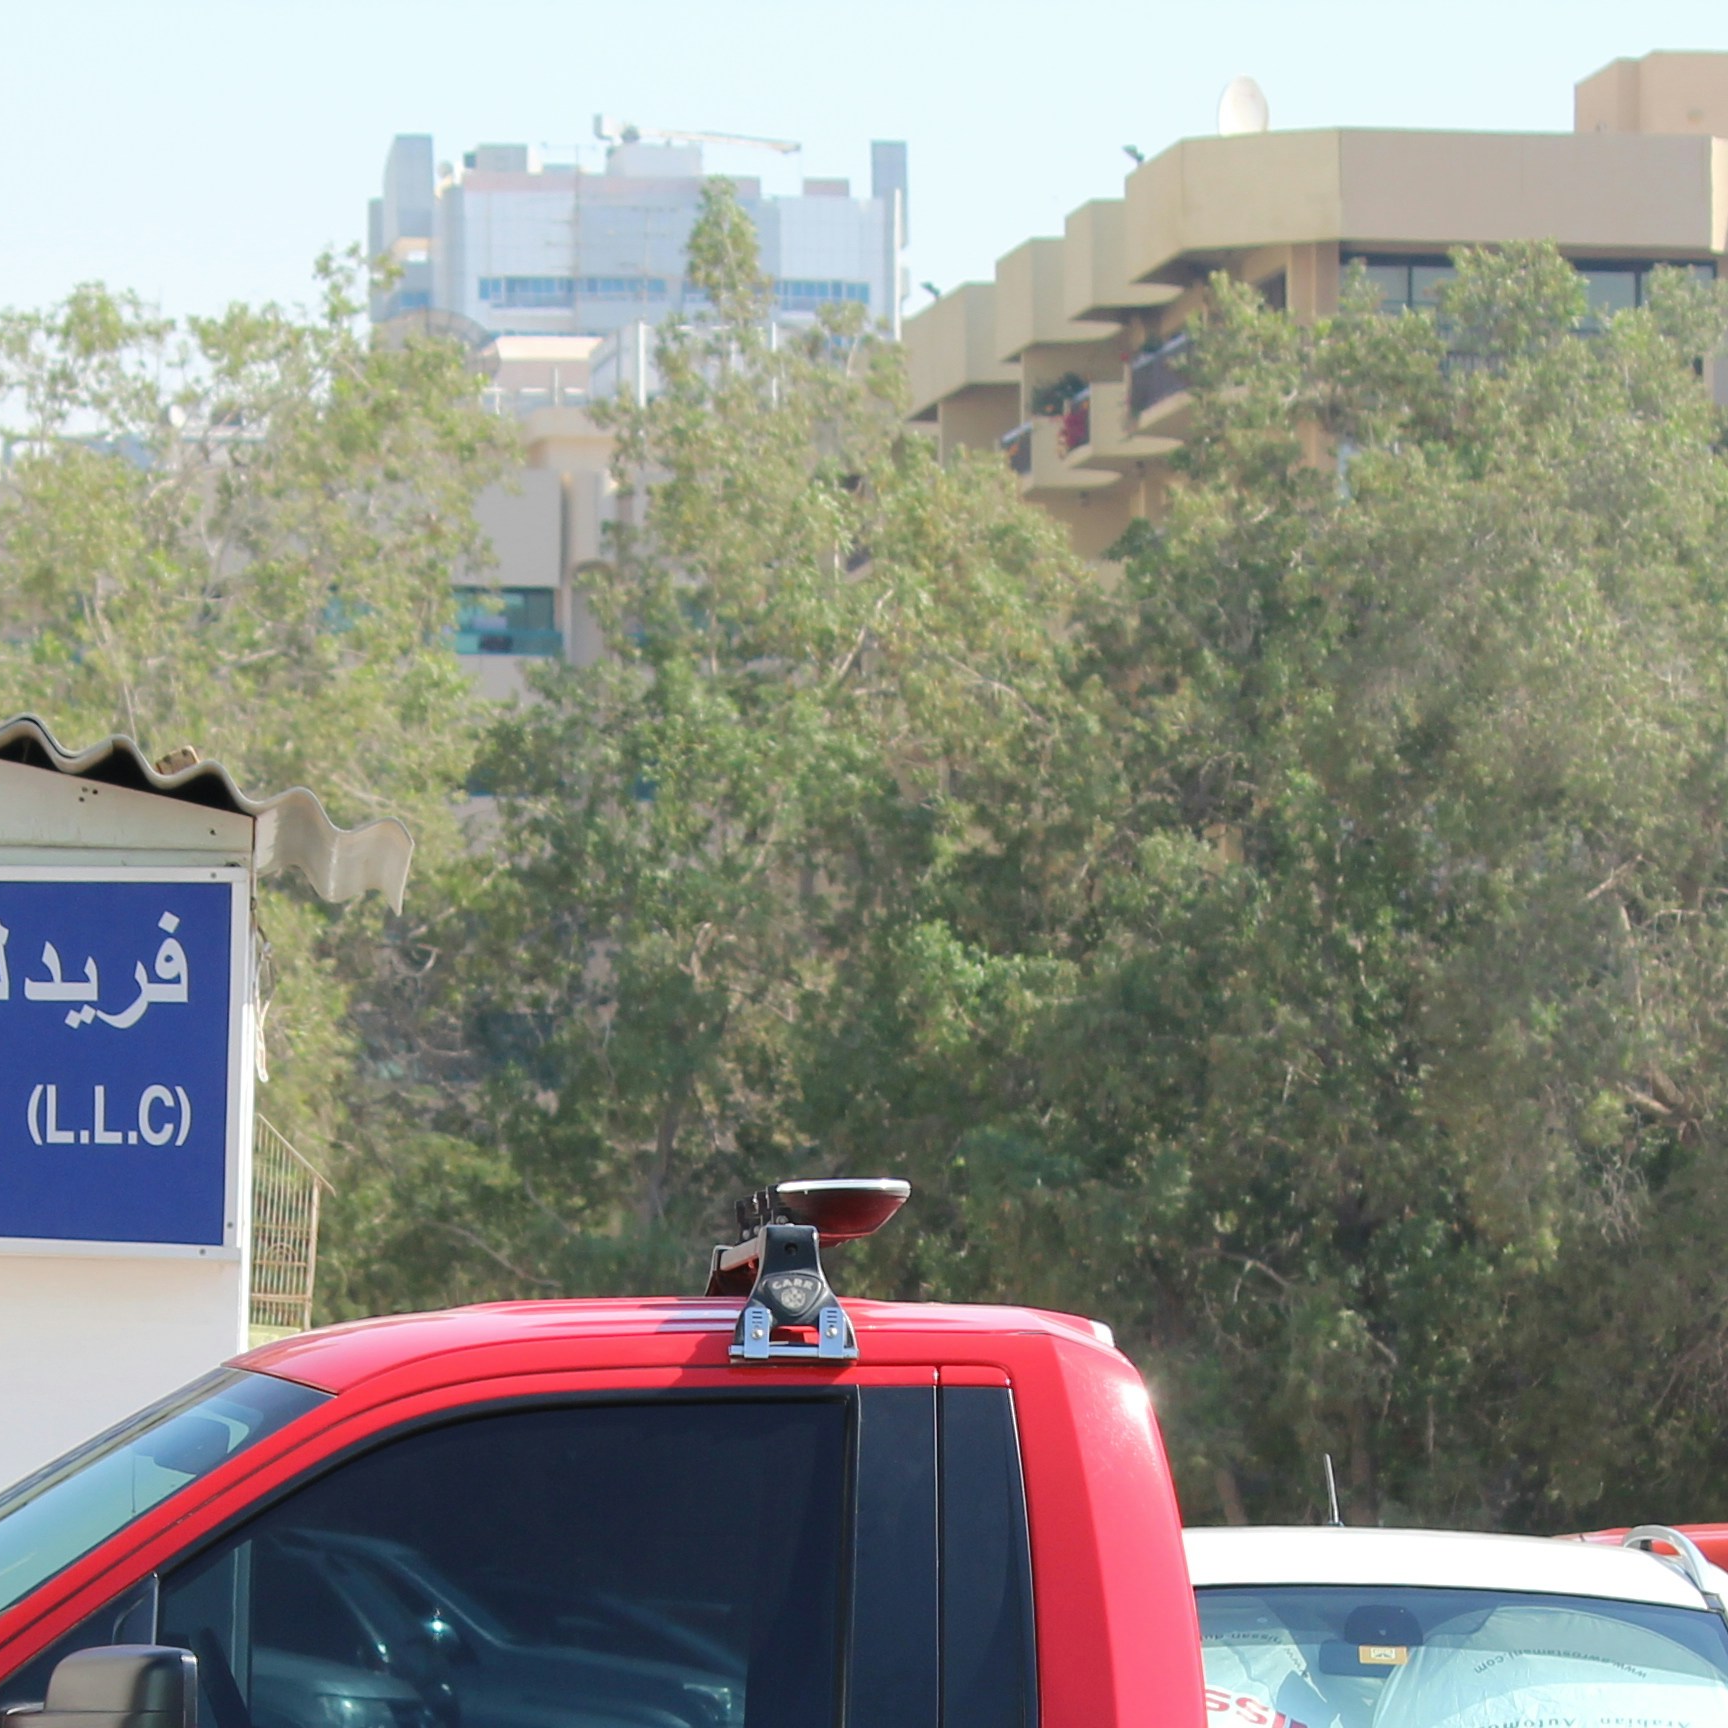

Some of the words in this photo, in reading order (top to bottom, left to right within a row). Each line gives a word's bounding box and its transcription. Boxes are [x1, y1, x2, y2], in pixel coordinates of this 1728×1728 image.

[23, 911, 190, 1029] فريد
[27, 1084, 192, 1147] (L.L.C)
[772, 1278, 814, 1290] CARR
